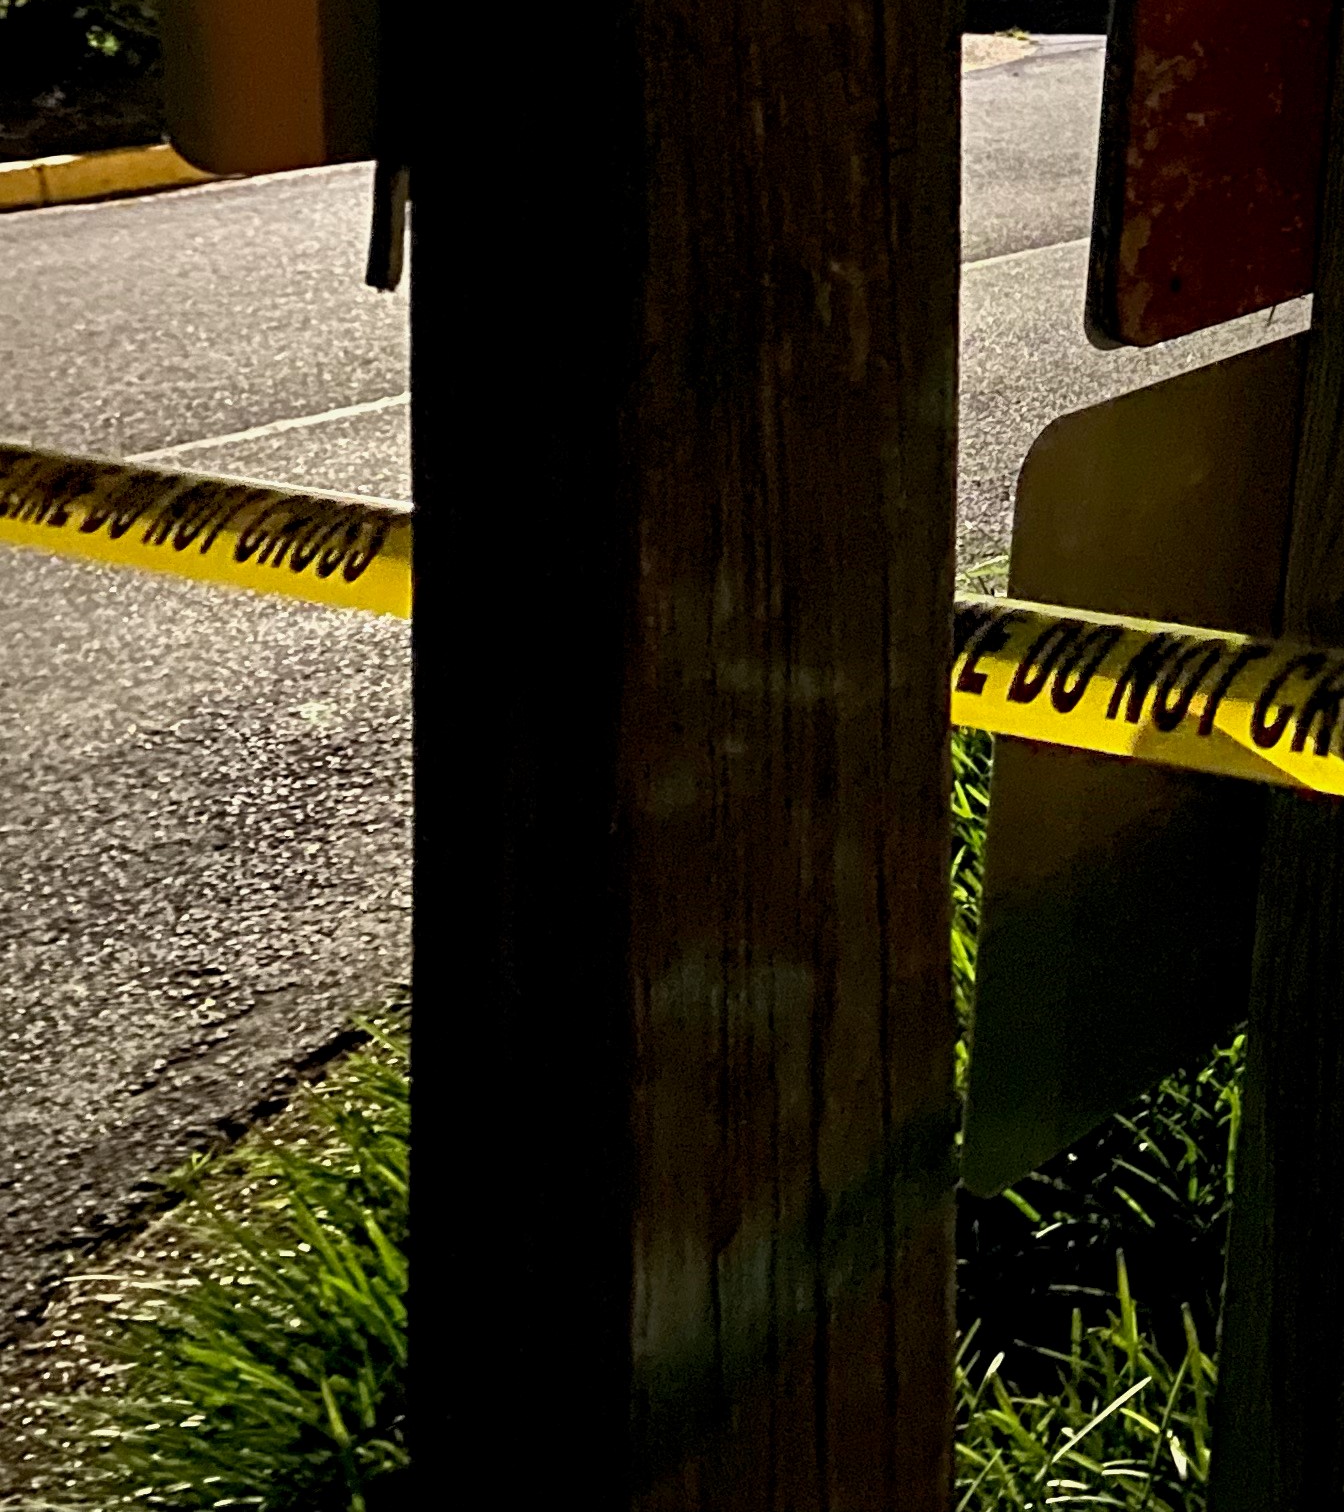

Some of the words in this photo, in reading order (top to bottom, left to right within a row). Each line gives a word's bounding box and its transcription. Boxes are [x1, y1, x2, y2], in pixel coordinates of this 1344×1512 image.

[234, 494, 394, 583] CROSS
[1006, 617, 1124, 714] DO
[1106, 632, 1273, 736] NOT
